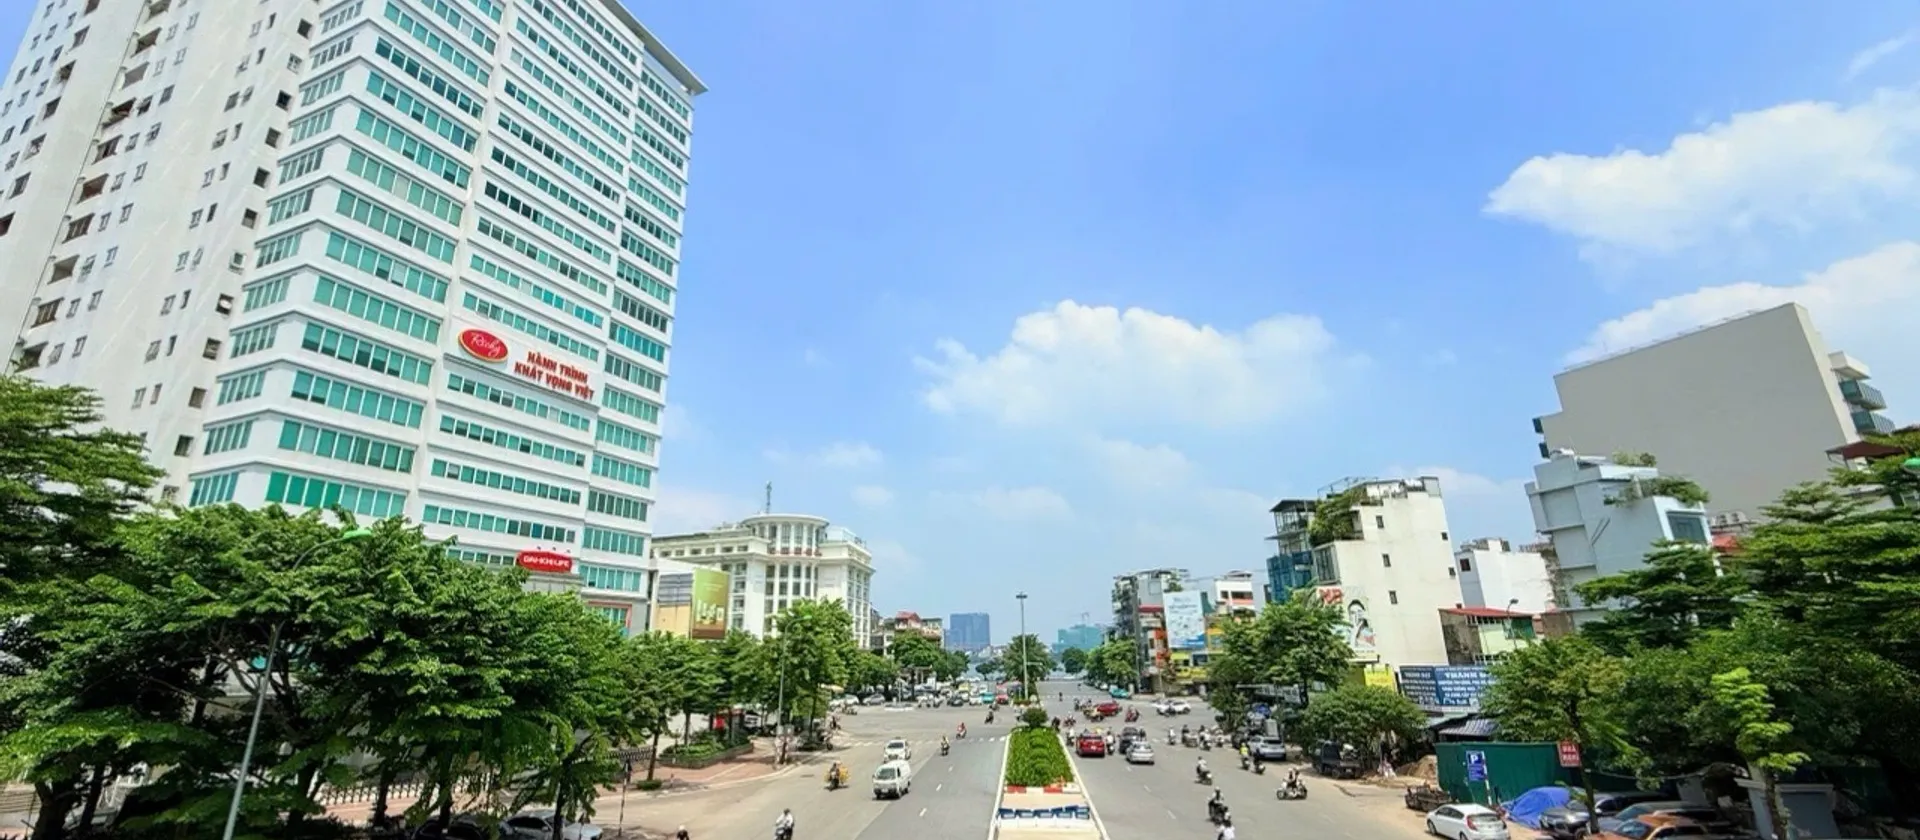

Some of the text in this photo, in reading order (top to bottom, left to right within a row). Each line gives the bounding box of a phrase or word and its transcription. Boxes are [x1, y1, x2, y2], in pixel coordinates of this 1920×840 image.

[514, 361, 595, 400] KHÁT VỌNG VIỆT
[527, 350, 588, 383] HÀNH TRÌNH
[1470, 755, 1479, 764] P
